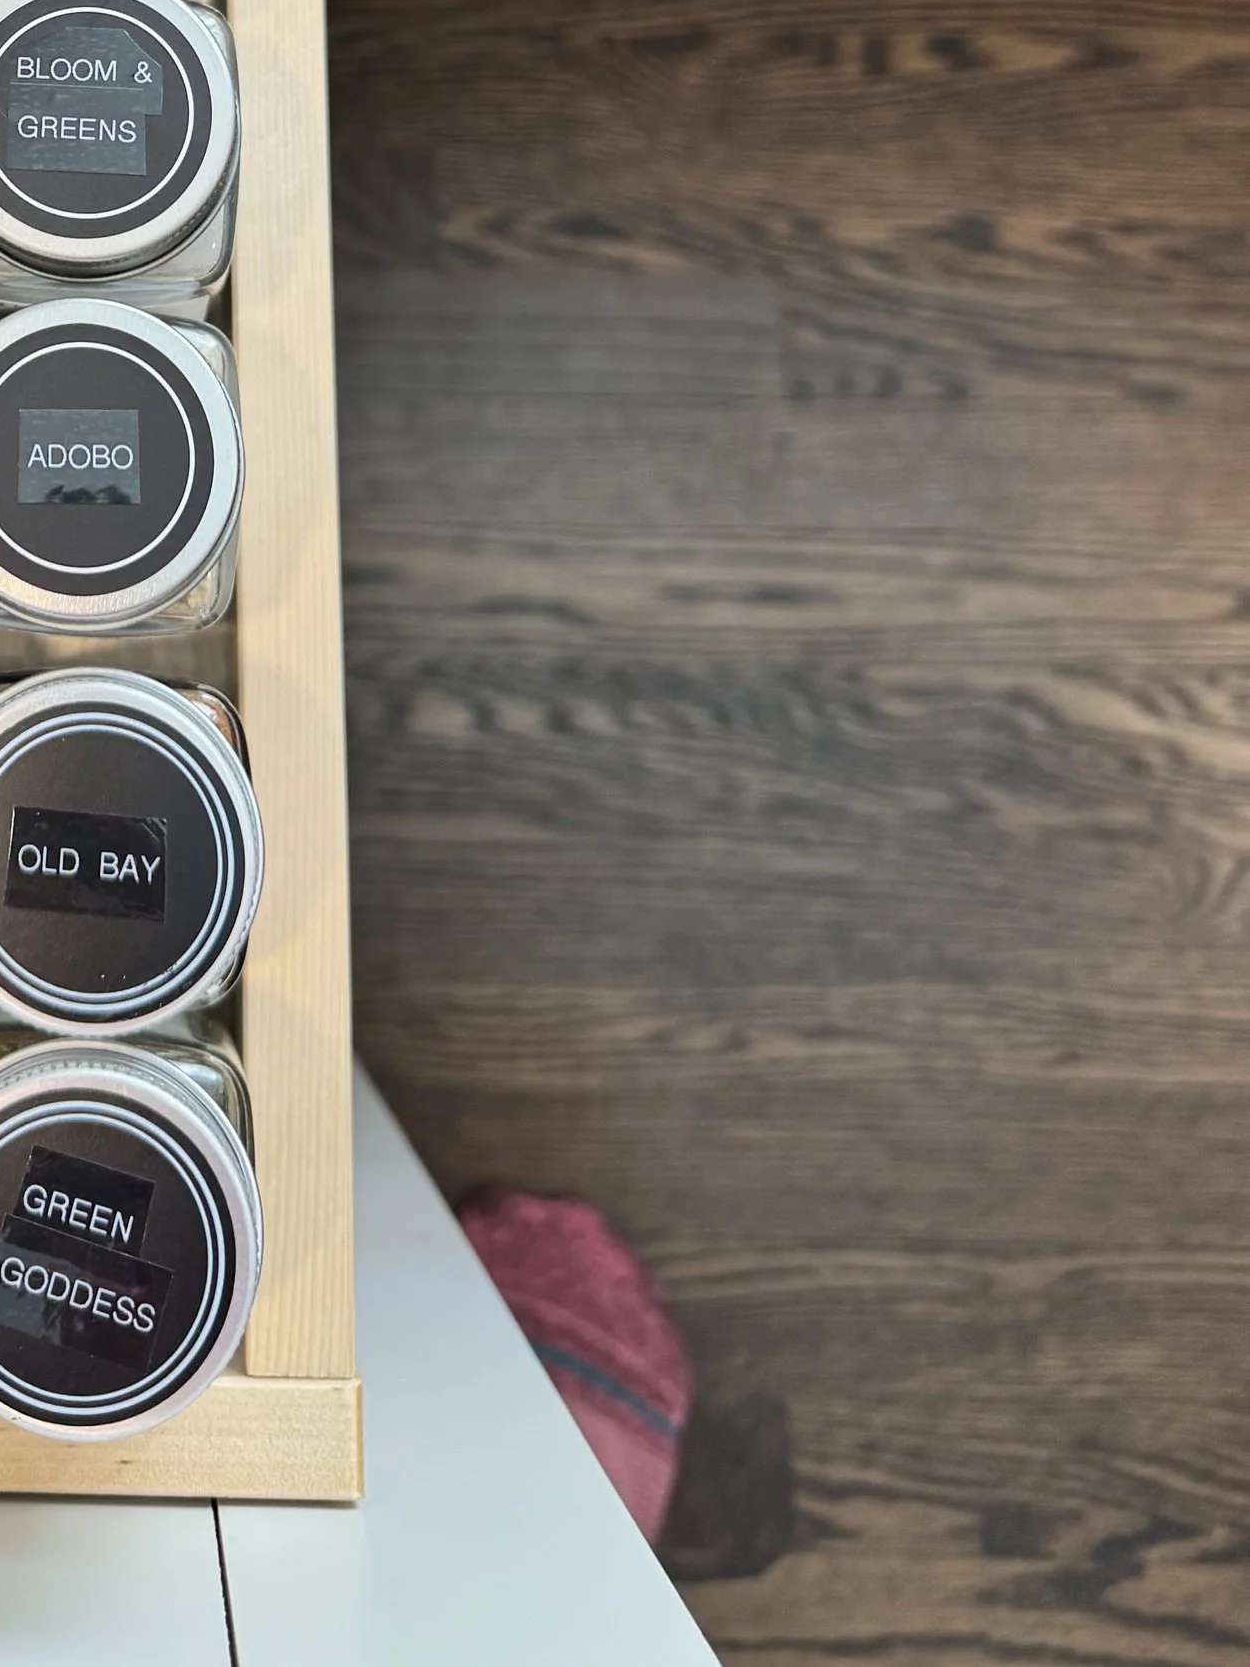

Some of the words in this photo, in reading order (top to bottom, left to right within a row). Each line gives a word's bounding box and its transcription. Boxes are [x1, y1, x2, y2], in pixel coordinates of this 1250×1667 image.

[15, 56, 119, 83] BLOOM
[133, 59, 155, 85] &
[15, 113, 139, 144] GREENS
[26, 442, 135, 472] ADOBO
[16, 843, 81, 877] OLD
[97, 850, 161, 883] BAY
[21, 1183, 137, 1245] GREEN
